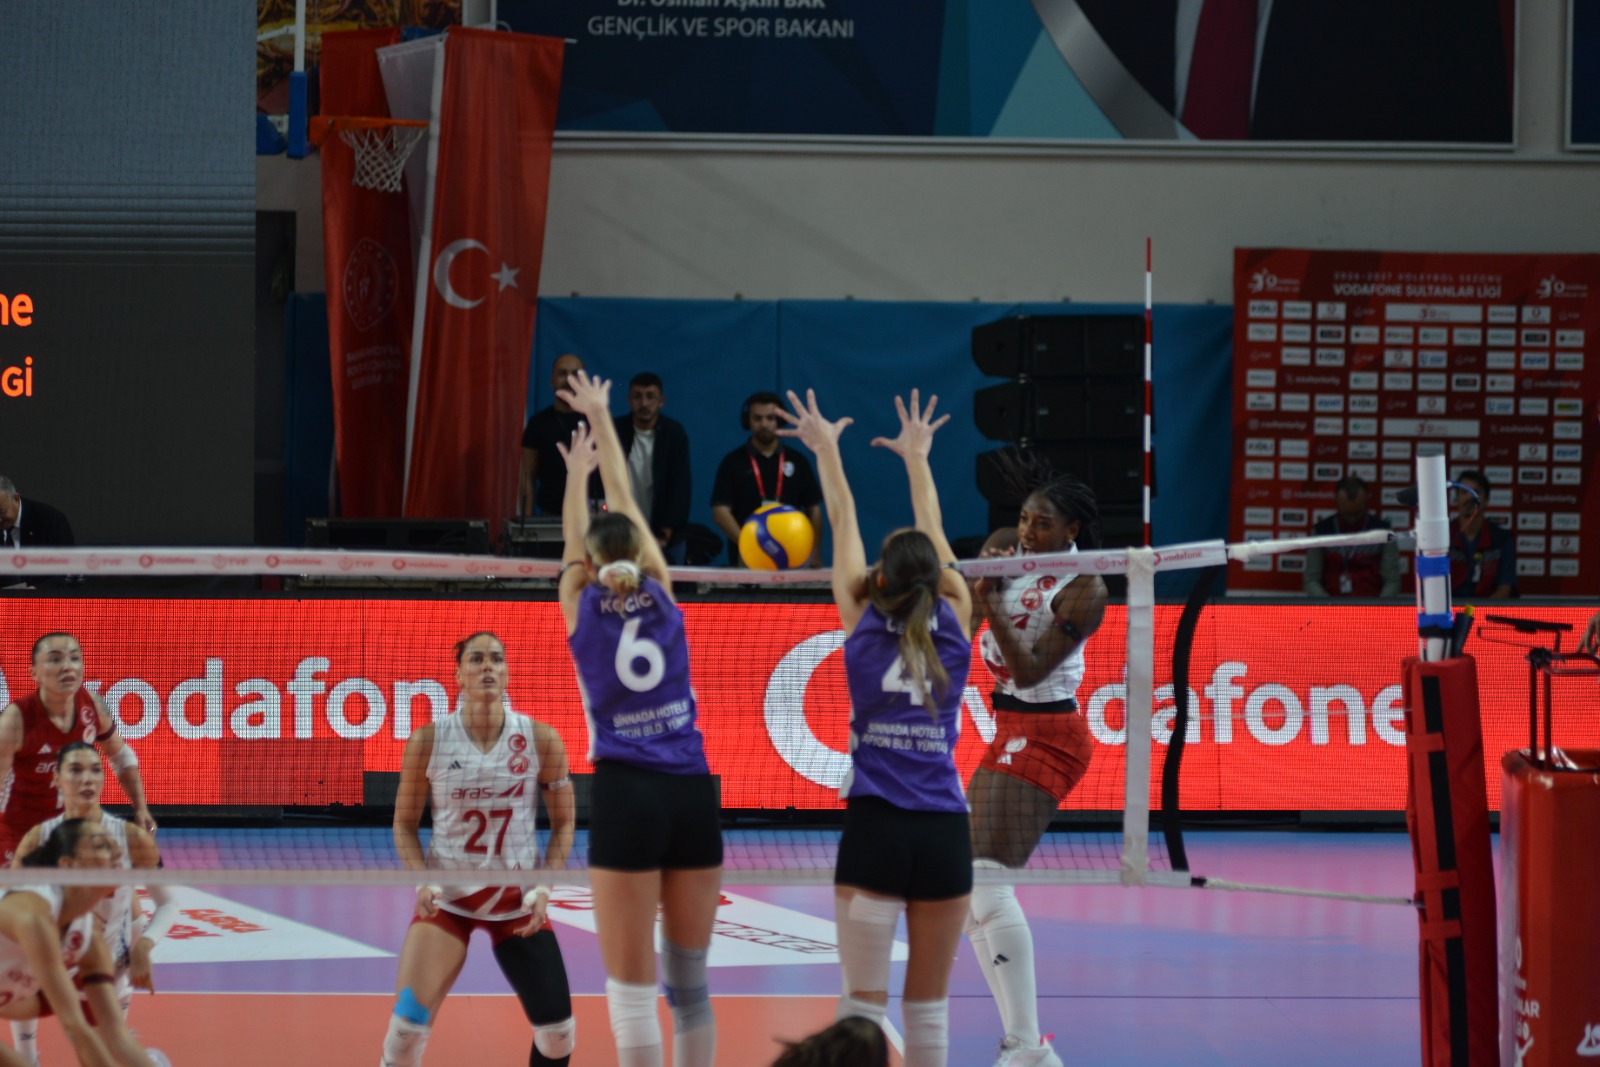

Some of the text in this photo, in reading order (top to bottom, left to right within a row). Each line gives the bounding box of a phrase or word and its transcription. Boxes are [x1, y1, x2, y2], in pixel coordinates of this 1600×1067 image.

[587, 13, 855, 40] GENÇLİK VE SPOR BAKANI
[1333, 283, 1403, 297] VODAFONE
[1405, 284, 1475, 299] SULTANLAR
[281, 557, 322, 567] vodafone
[1163, 549, 1204, 563] vodafone
[407, 560, 449, 570] vodafone
[1038, 560, 1079, 570] vodafone
[614, 616, 667, 693] 6
[881, 648, 933, 706] 4
[450, 787, 493, 800] aras
[462, 808, 514, 857] 27
